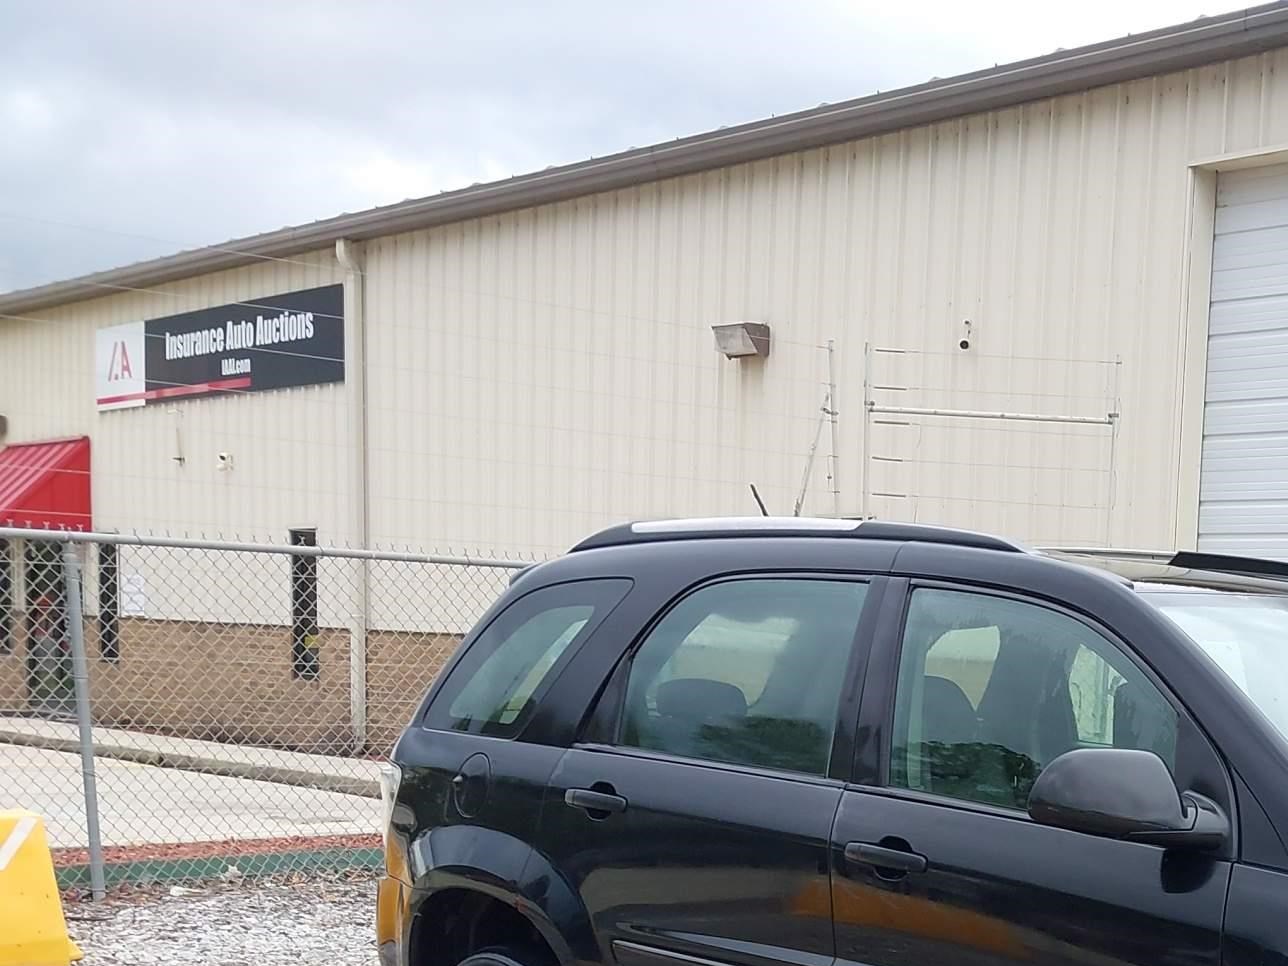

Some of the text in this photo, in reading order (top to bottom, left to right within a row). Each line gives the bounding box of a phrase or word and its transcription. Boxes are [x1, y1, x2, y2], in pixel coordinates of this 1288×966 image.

[165, 311, 314, 360] Insurance Auto Auctions
